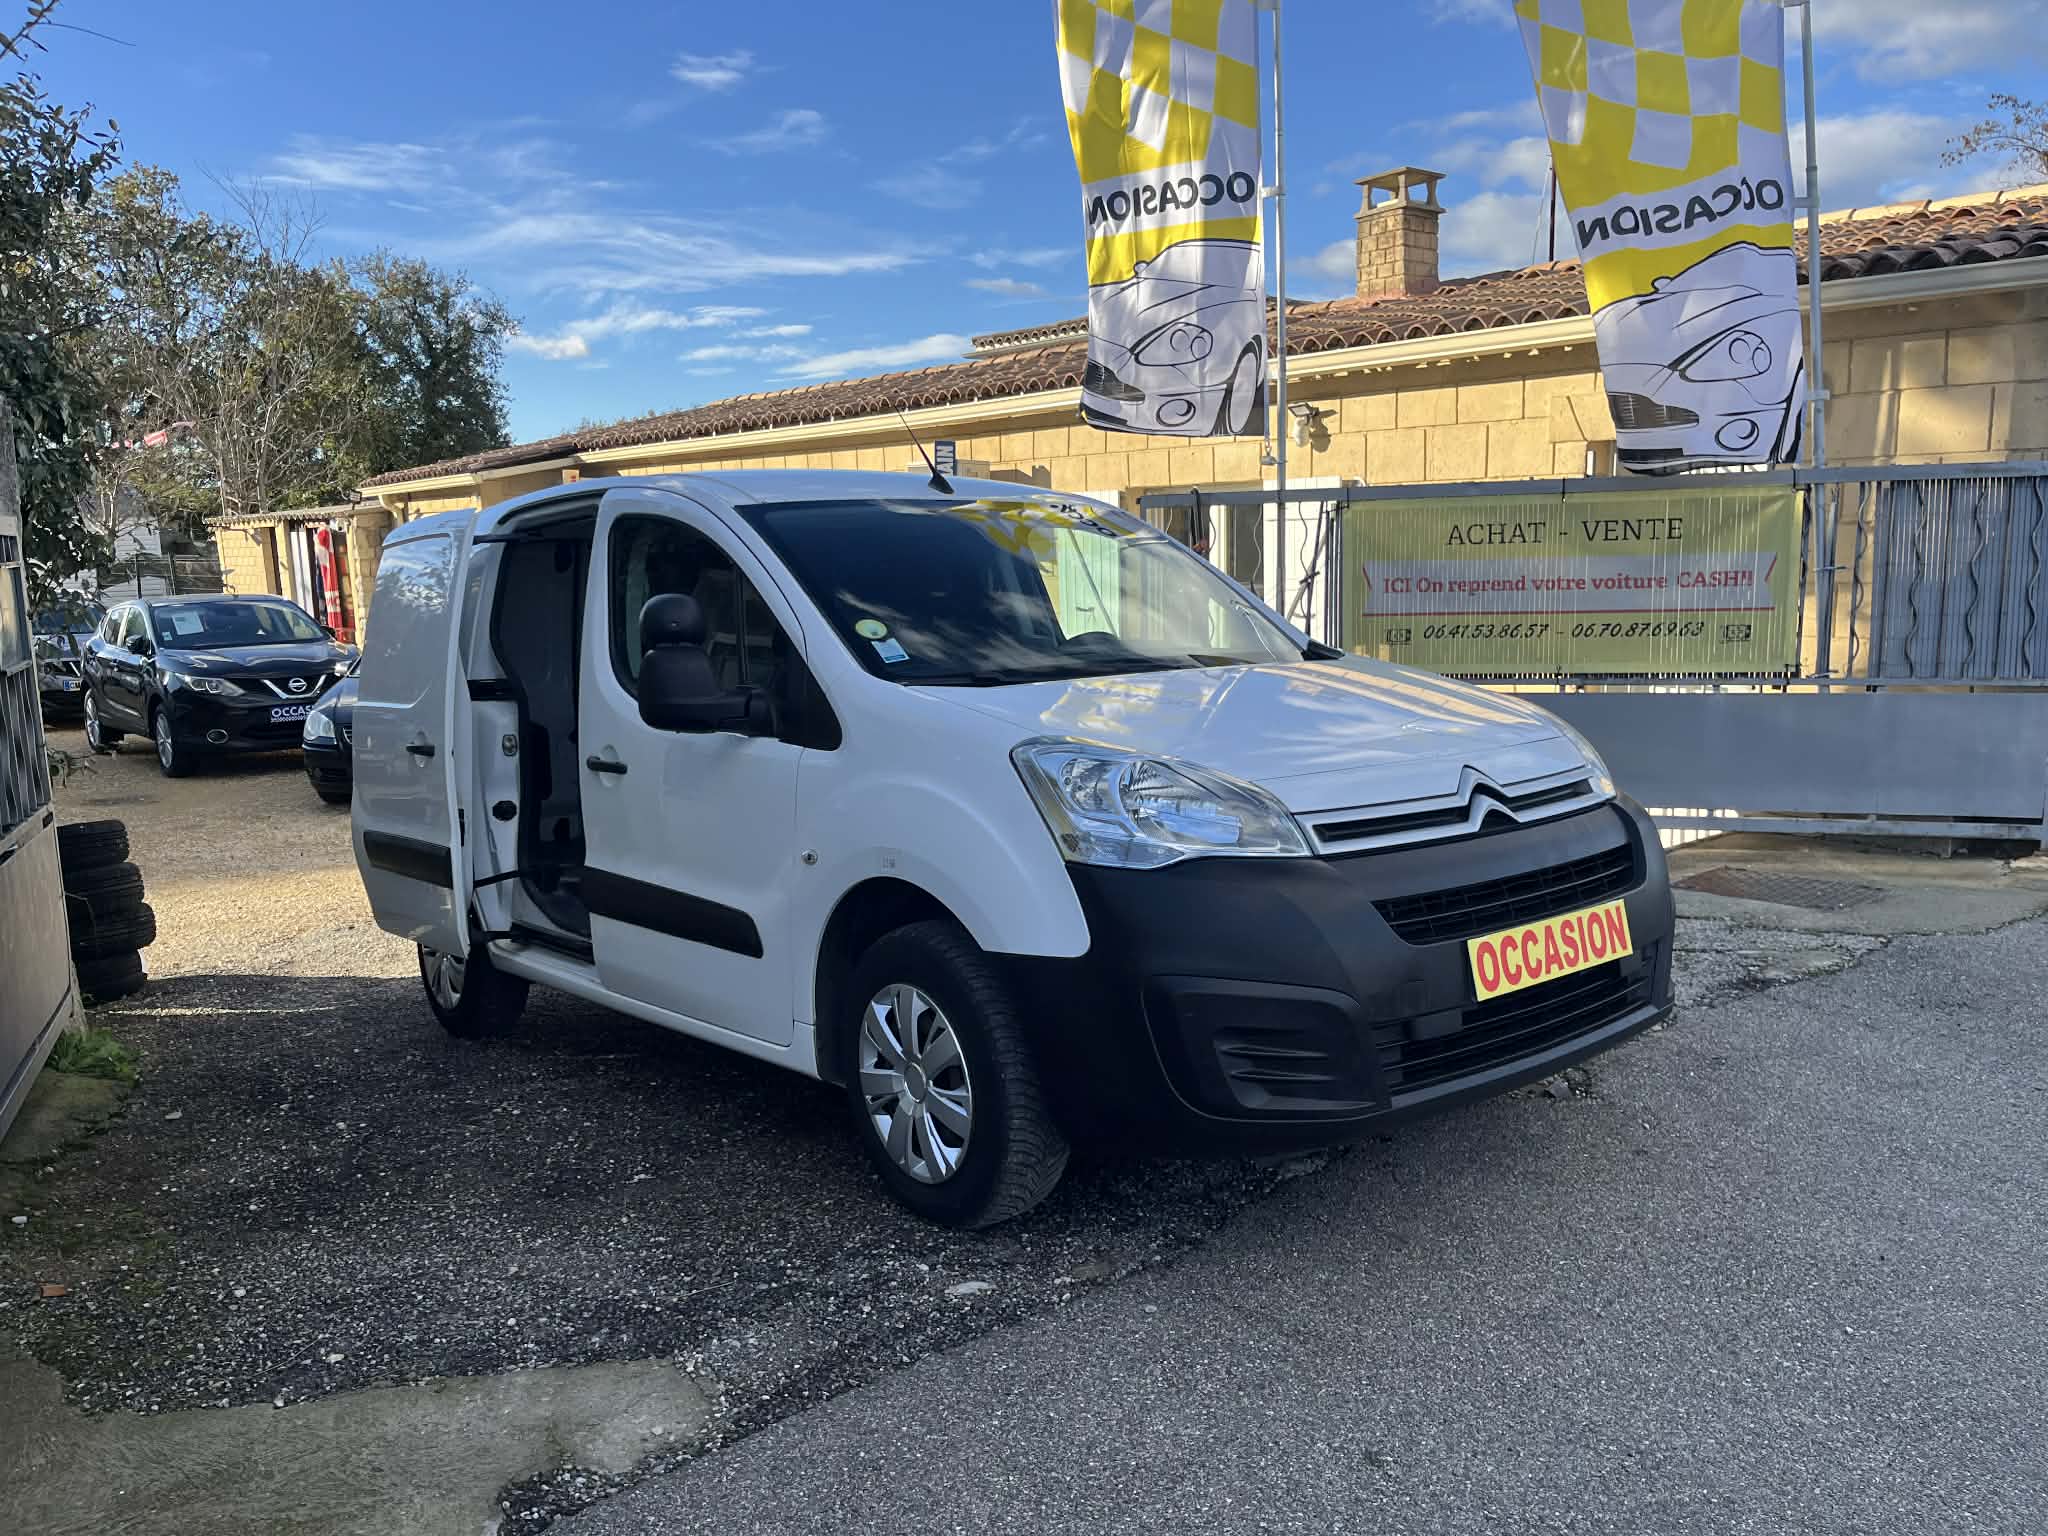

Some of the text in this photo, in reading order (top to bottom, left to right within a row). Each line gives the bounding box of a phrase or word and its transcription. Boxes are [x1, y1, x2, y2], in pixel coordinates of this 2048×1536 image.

[1447, 522, 1546, 546] ACHAT
[1581, 518, 1683, 541] VENTE
[1384, 577, 1412, 593] ICI
[1416, 577, 1444, 593] On
[1448, 575, 1526, 599] reprend
[1532, 576, 1586, 591] votre
[1592, 572, 1667, 590] voiture
[1476, 905, 1628, 993] OCCASION
